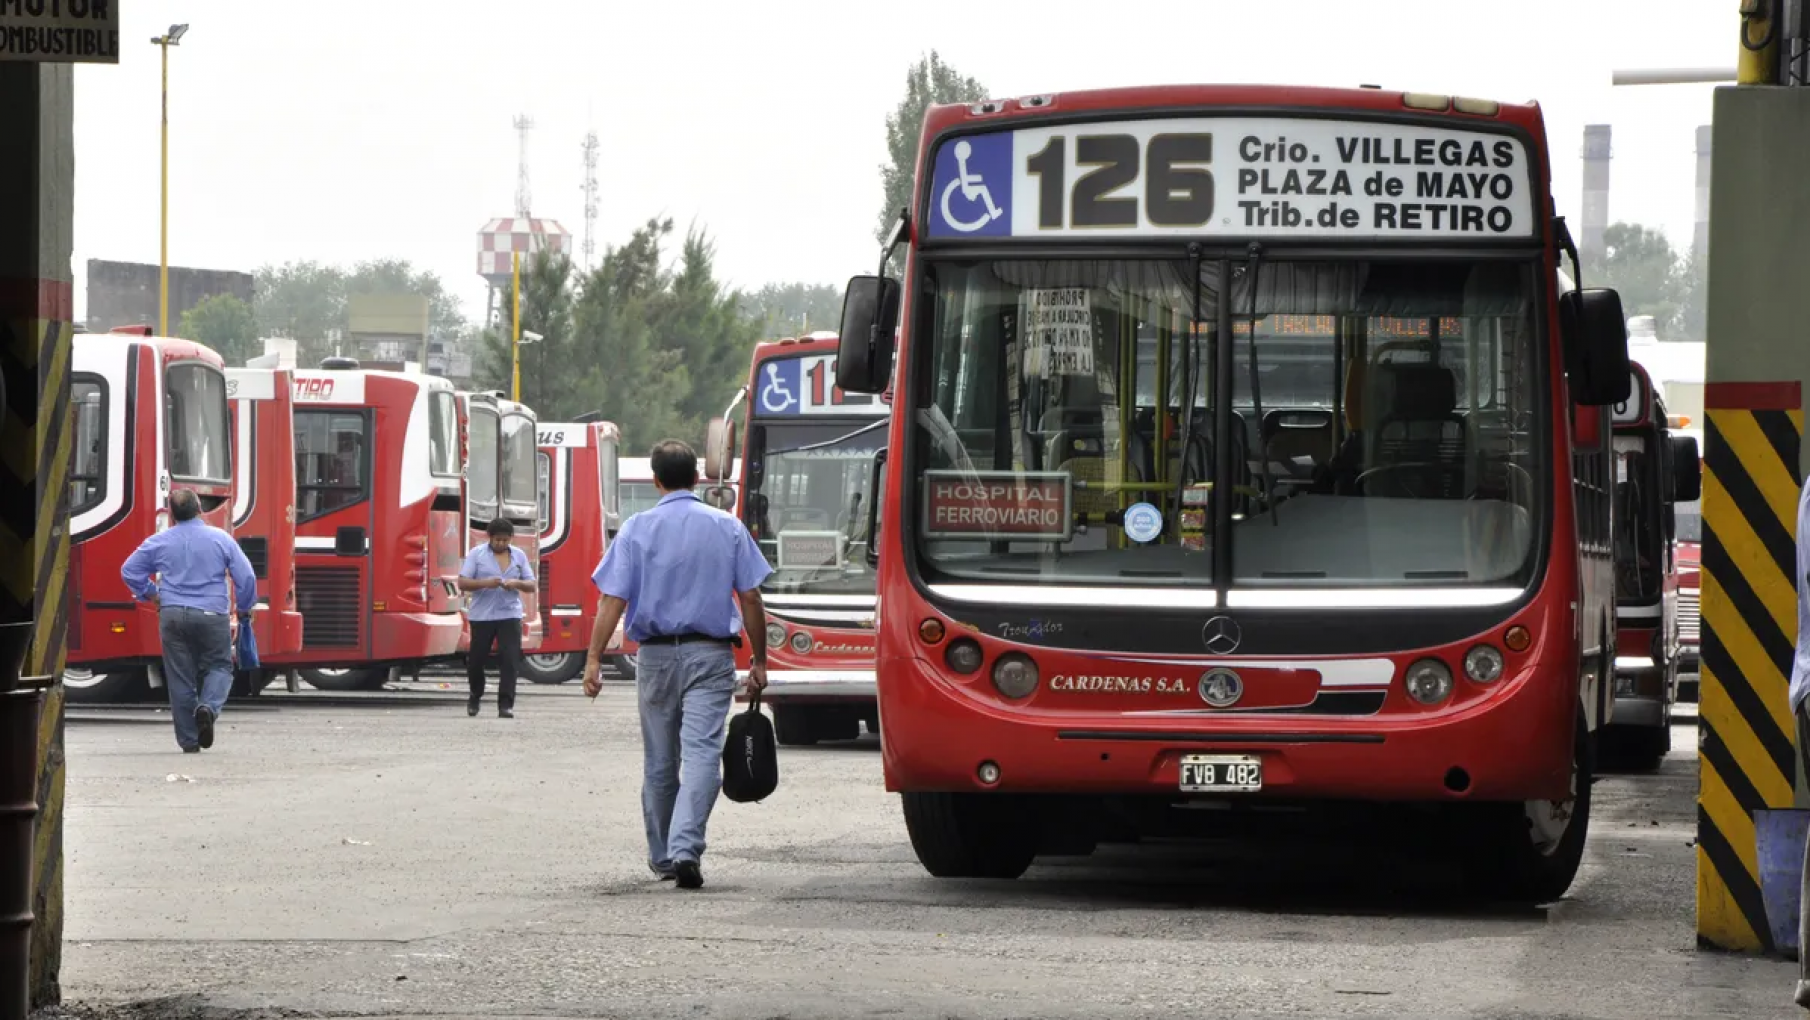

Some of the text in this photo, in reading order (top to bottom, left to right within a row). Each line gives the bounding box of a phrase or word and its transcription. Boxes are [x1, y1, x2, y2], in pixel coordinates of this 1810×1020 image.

[1239, 135, 1514, 168] Crio. VILLEGAS
[1026, 132, 1215, 231] 126
[1238, 168, 1513, 200] PLAZA de MAYO
[1373, 203, 1513, 232] RETIRO
[936, 485, 1059, 501] HOSPITAL
[936, 506, 1059, 526] FERROVIARIO
[1050, 675, 1191, 693] CARDENAS S.A.
[1183, 764, 1260, 784] FVB 482
